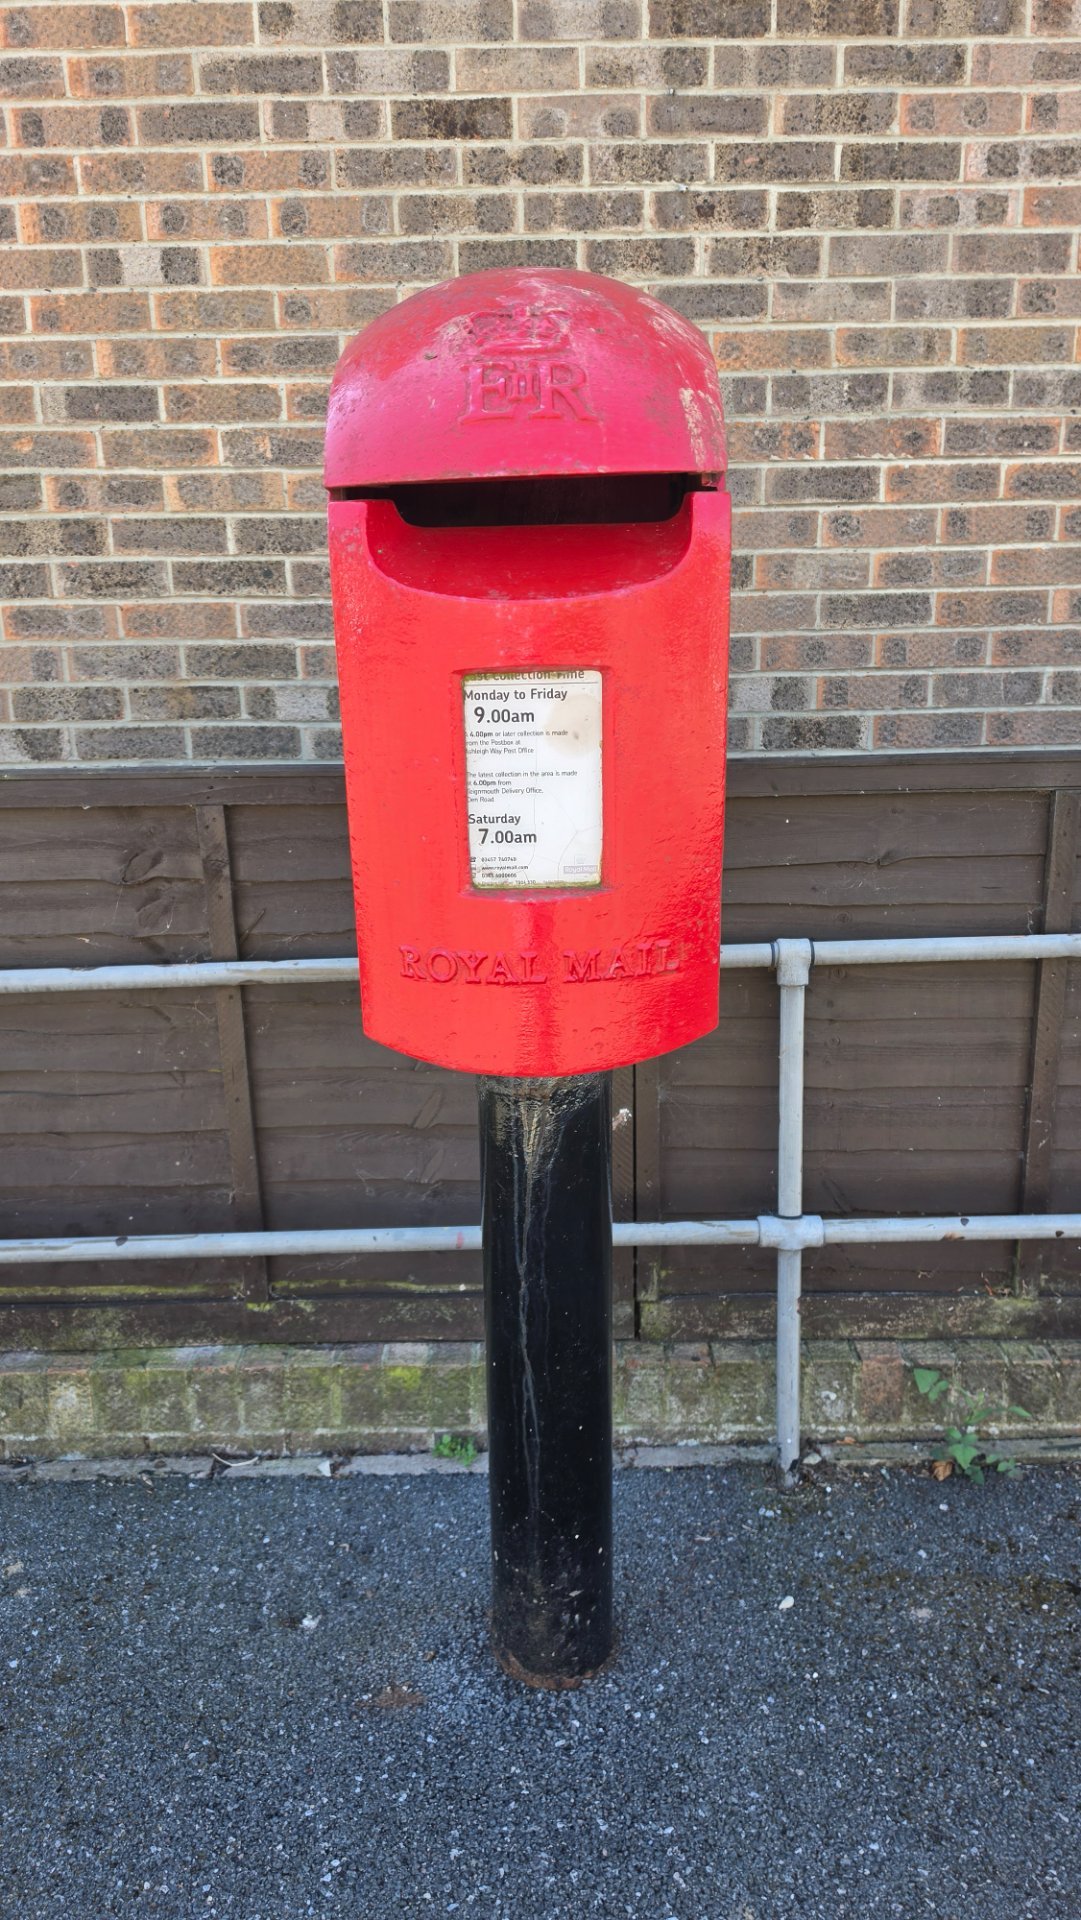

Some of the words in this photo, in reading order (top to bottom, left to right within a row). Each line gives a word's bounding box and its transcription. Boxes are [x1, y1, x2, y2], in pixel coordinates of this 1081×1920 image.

[465, 690, 509, 702] Monday
[514, 690, 525, 700] to
[530, 688, 568, 701] Friday
[474, 706, 534, 723] 9.00am
[468, 814, 521, 825] Saturday
[478, 828, 537, 844] 7.00am
[399, 945, 547, 985] ROYAL
[562, 939, 681, 983] MAIL
